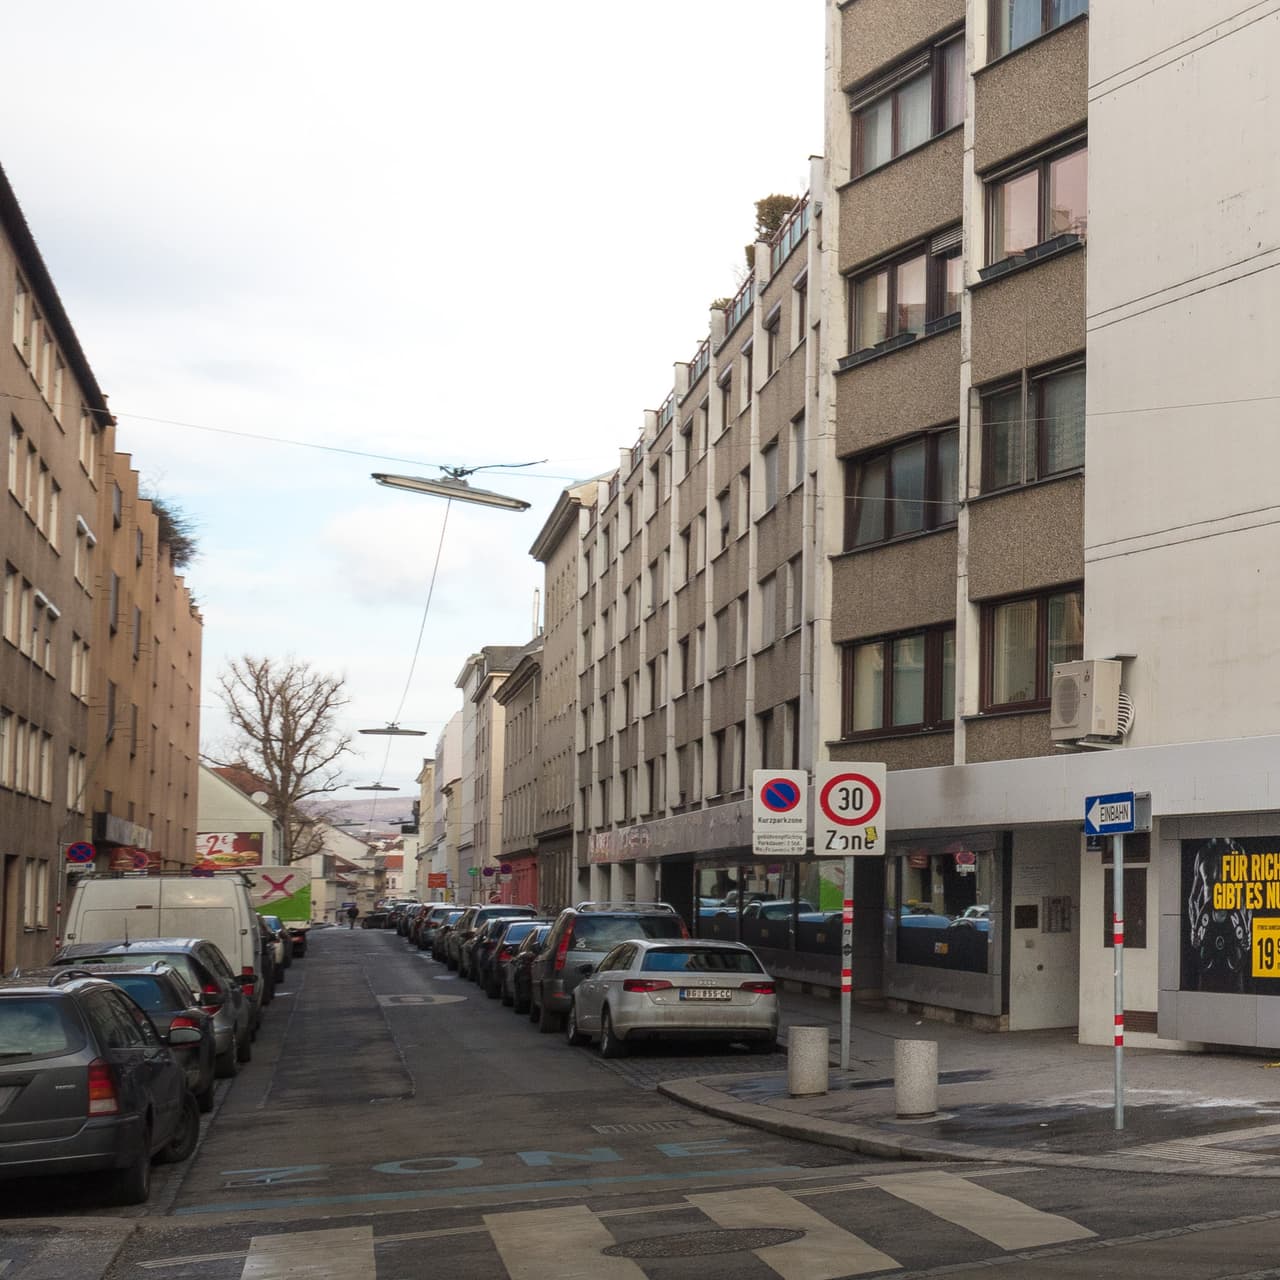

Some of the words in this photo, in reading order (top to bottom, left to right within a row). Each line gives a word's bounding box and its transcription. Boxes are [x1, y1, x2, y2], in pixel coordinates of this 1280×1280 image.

[838, 787, 863, 810] 30
[758, 816, 803, 825] Kurzparkzone
[1100, 803, 1130, 823] EINBAHN
[1222, 851, 1248, 882] FÜR
[1213, 882, 1243, 910] GIBT
[1245, 882, 1263, 910] ES
[1257, 937, 1274, 970] 19
[218, 1139, 751, 1186] ZONE
